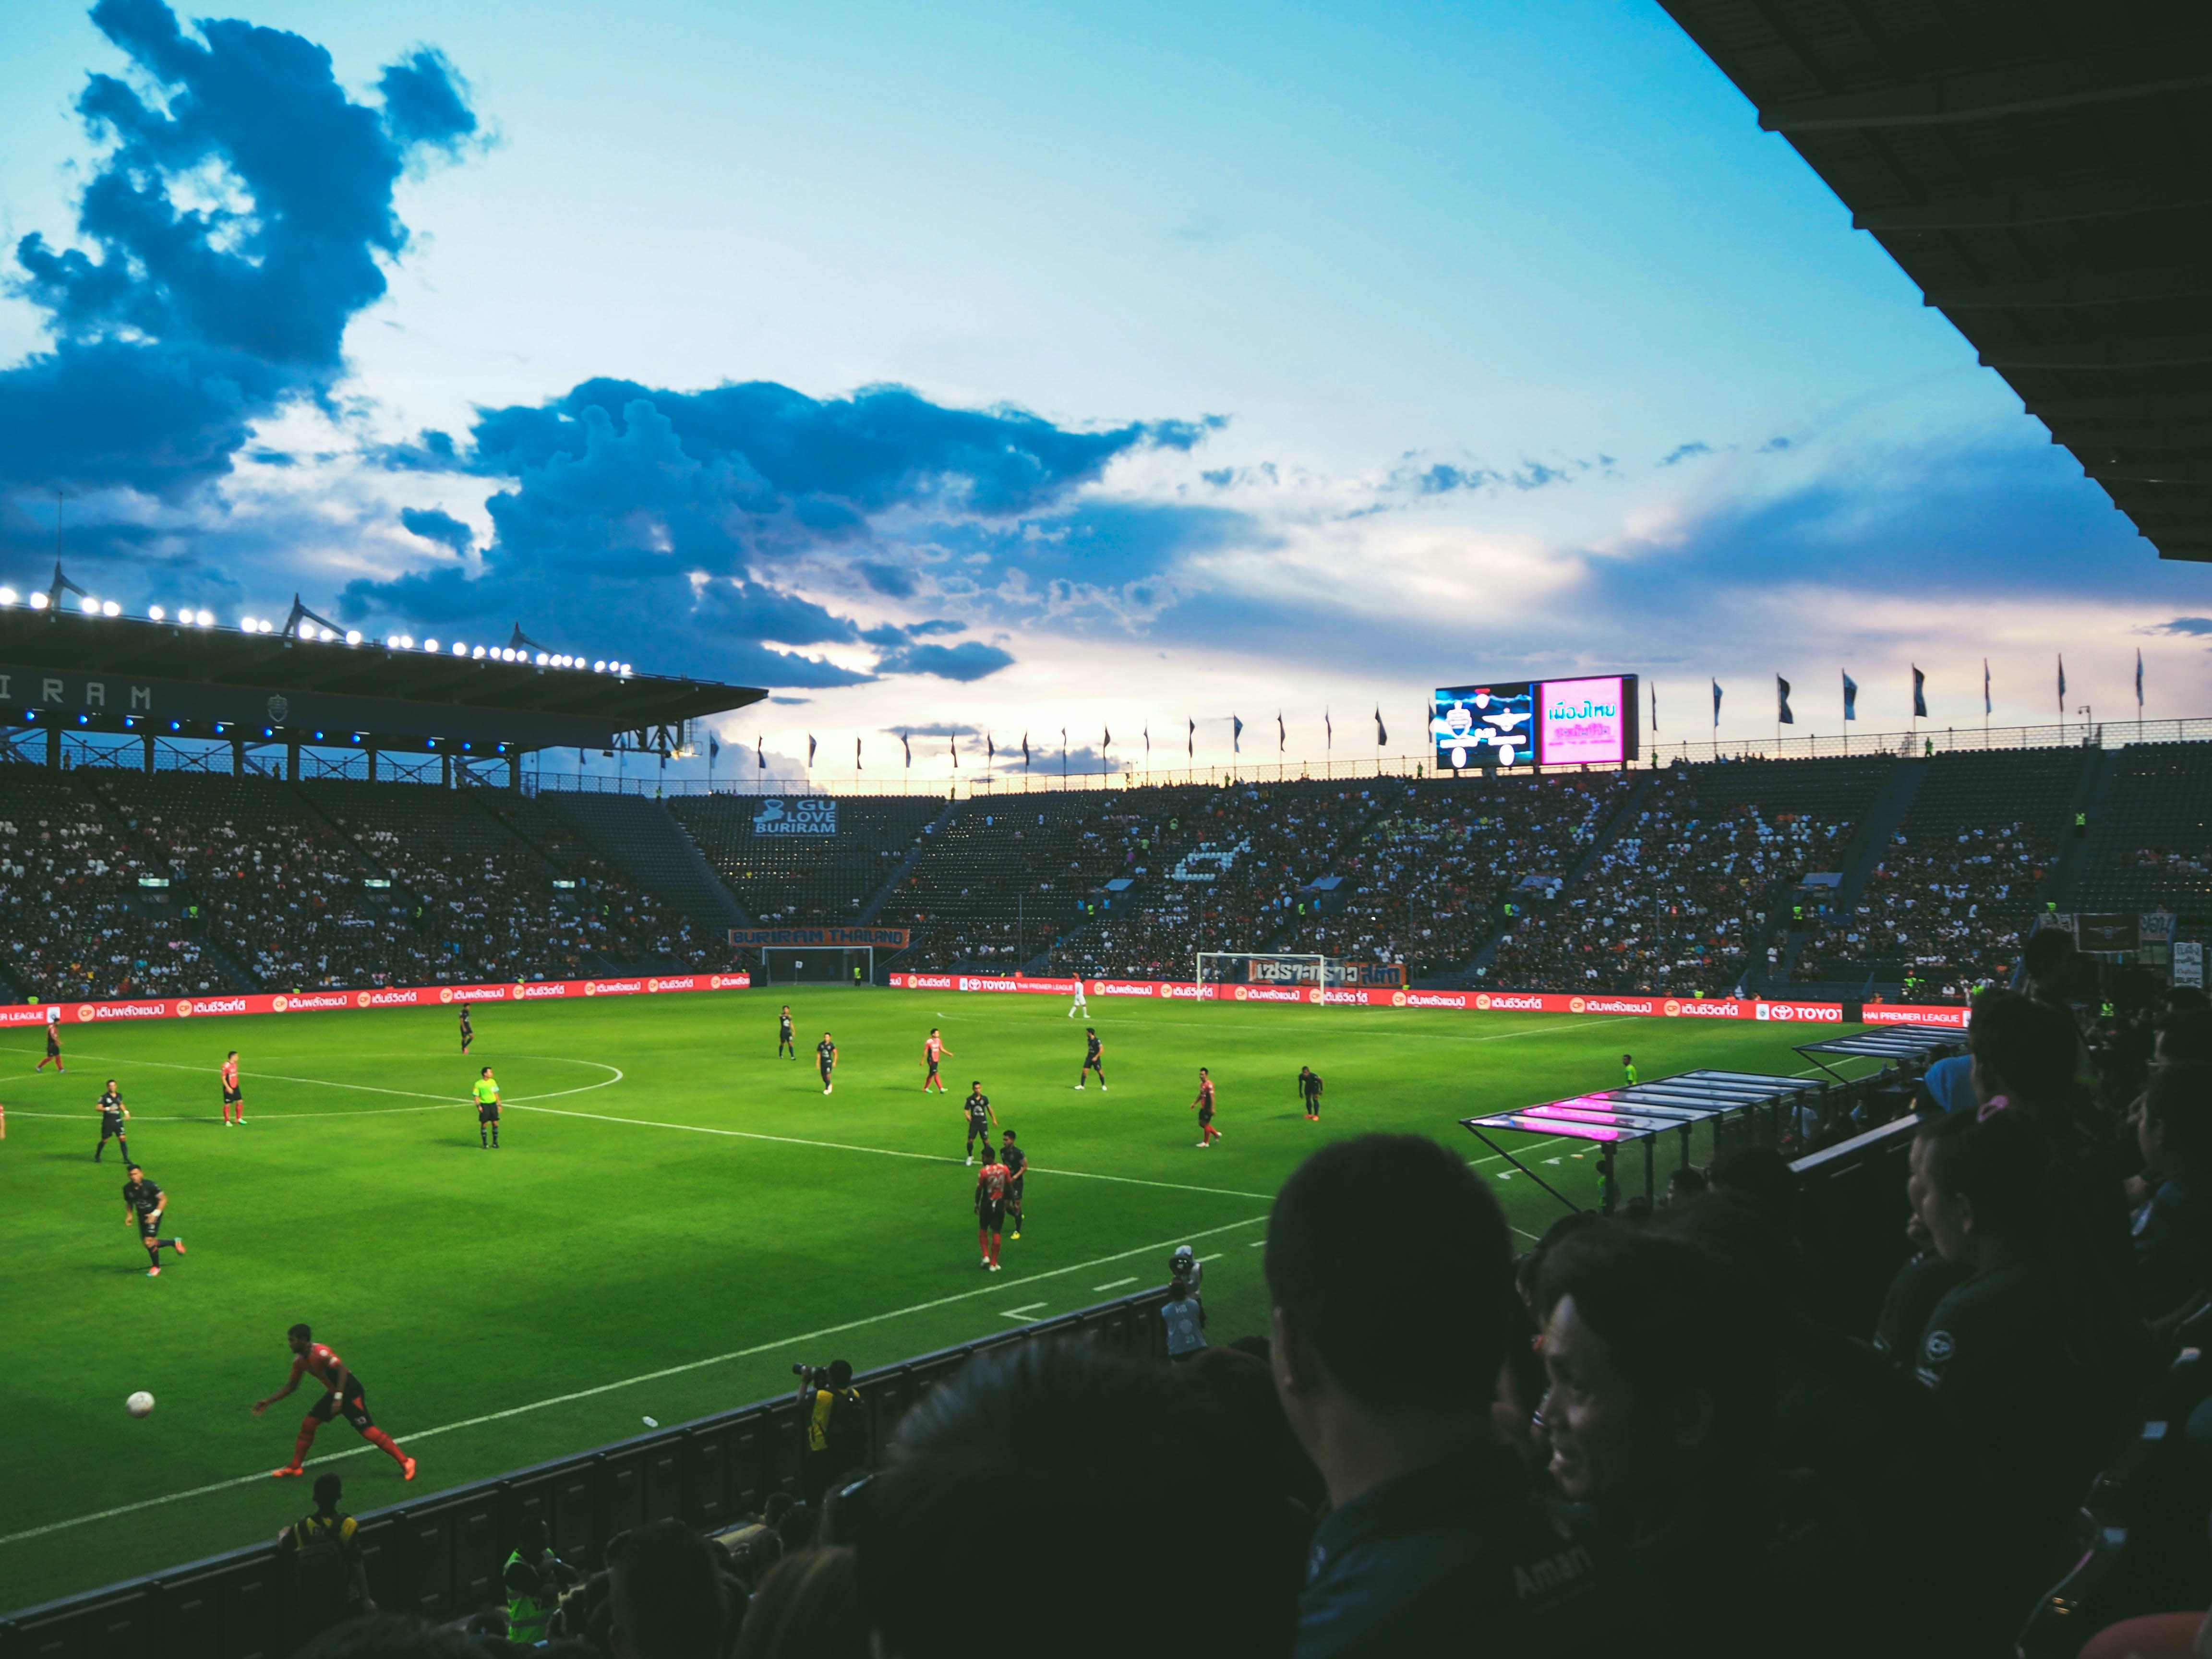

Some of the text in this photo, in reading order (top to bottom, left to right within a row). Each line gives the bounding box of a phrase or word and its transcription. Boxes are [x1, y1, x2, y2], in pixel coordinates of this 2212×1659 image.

[1549, 700, 1615, 720] เมืองไทย
[797, 799, 836, 811] GU
[787, 811, 836, 822] LOVE
[756, 823, 836, 833] BURIRAM
[733, 929, 903, 945] BURIRAM THAILAND
[982, 980, 1017, 990] TOYOTA
[372, 990, 417, 1004] เติมชีวิตที่ดี
[1491, 996, 1542, 1010] เติมชีวิตที่ดี
[193, 998, 246, 1013] เติมชีวิตที่ดี
[1682, 1001, 1739, 1016] เติมชีวิตที่ดี
[9, 1011, 44, 1021] LEAGUE
[1880, 1011, 1921, 1021] PREMIER
[1923, 1013, 1959, 1023] LEAGUE
